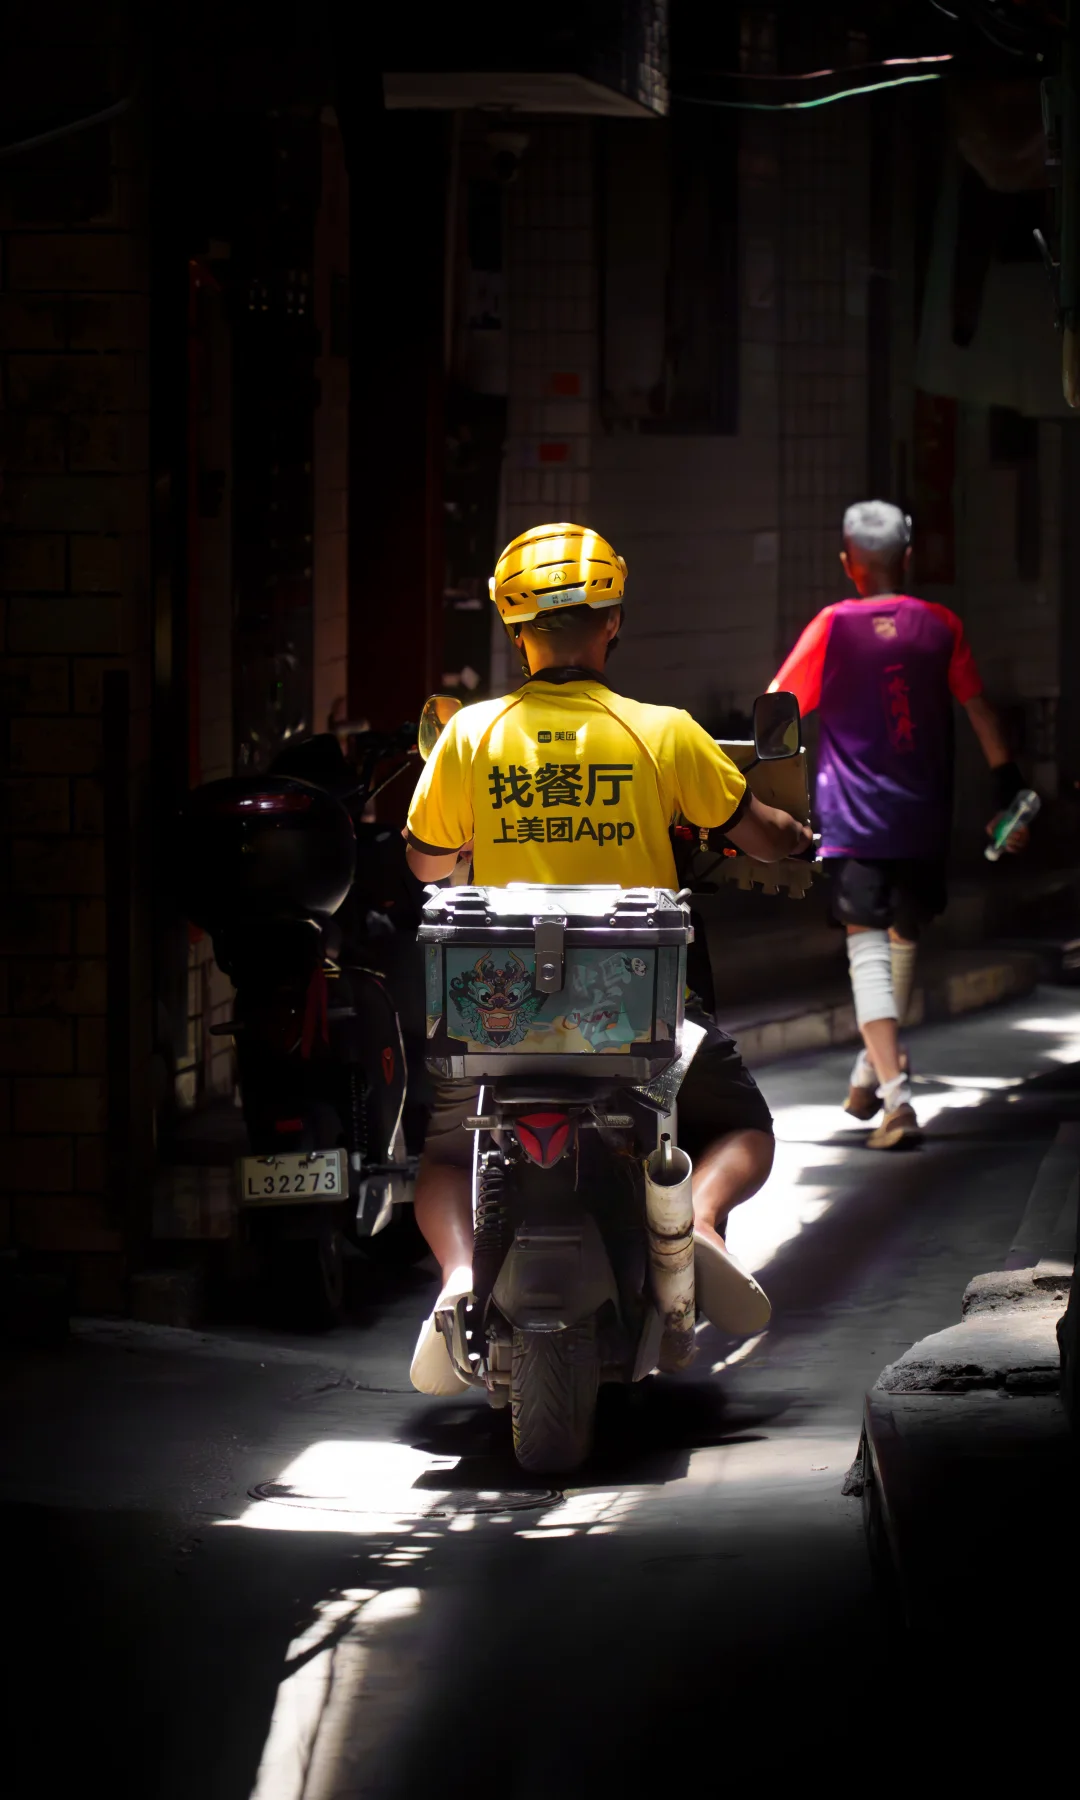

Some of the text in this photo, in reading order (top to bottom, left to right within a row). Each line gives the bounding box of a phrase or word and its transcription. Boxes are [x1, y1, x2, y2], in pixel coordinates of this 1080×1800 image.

[554, 731, 576, 741] 美团
[488, 763, 633, 809] 找餐厅
[493, 817, 635, 846] 上美团App
[248, 1172, 336, 1195] L32273
